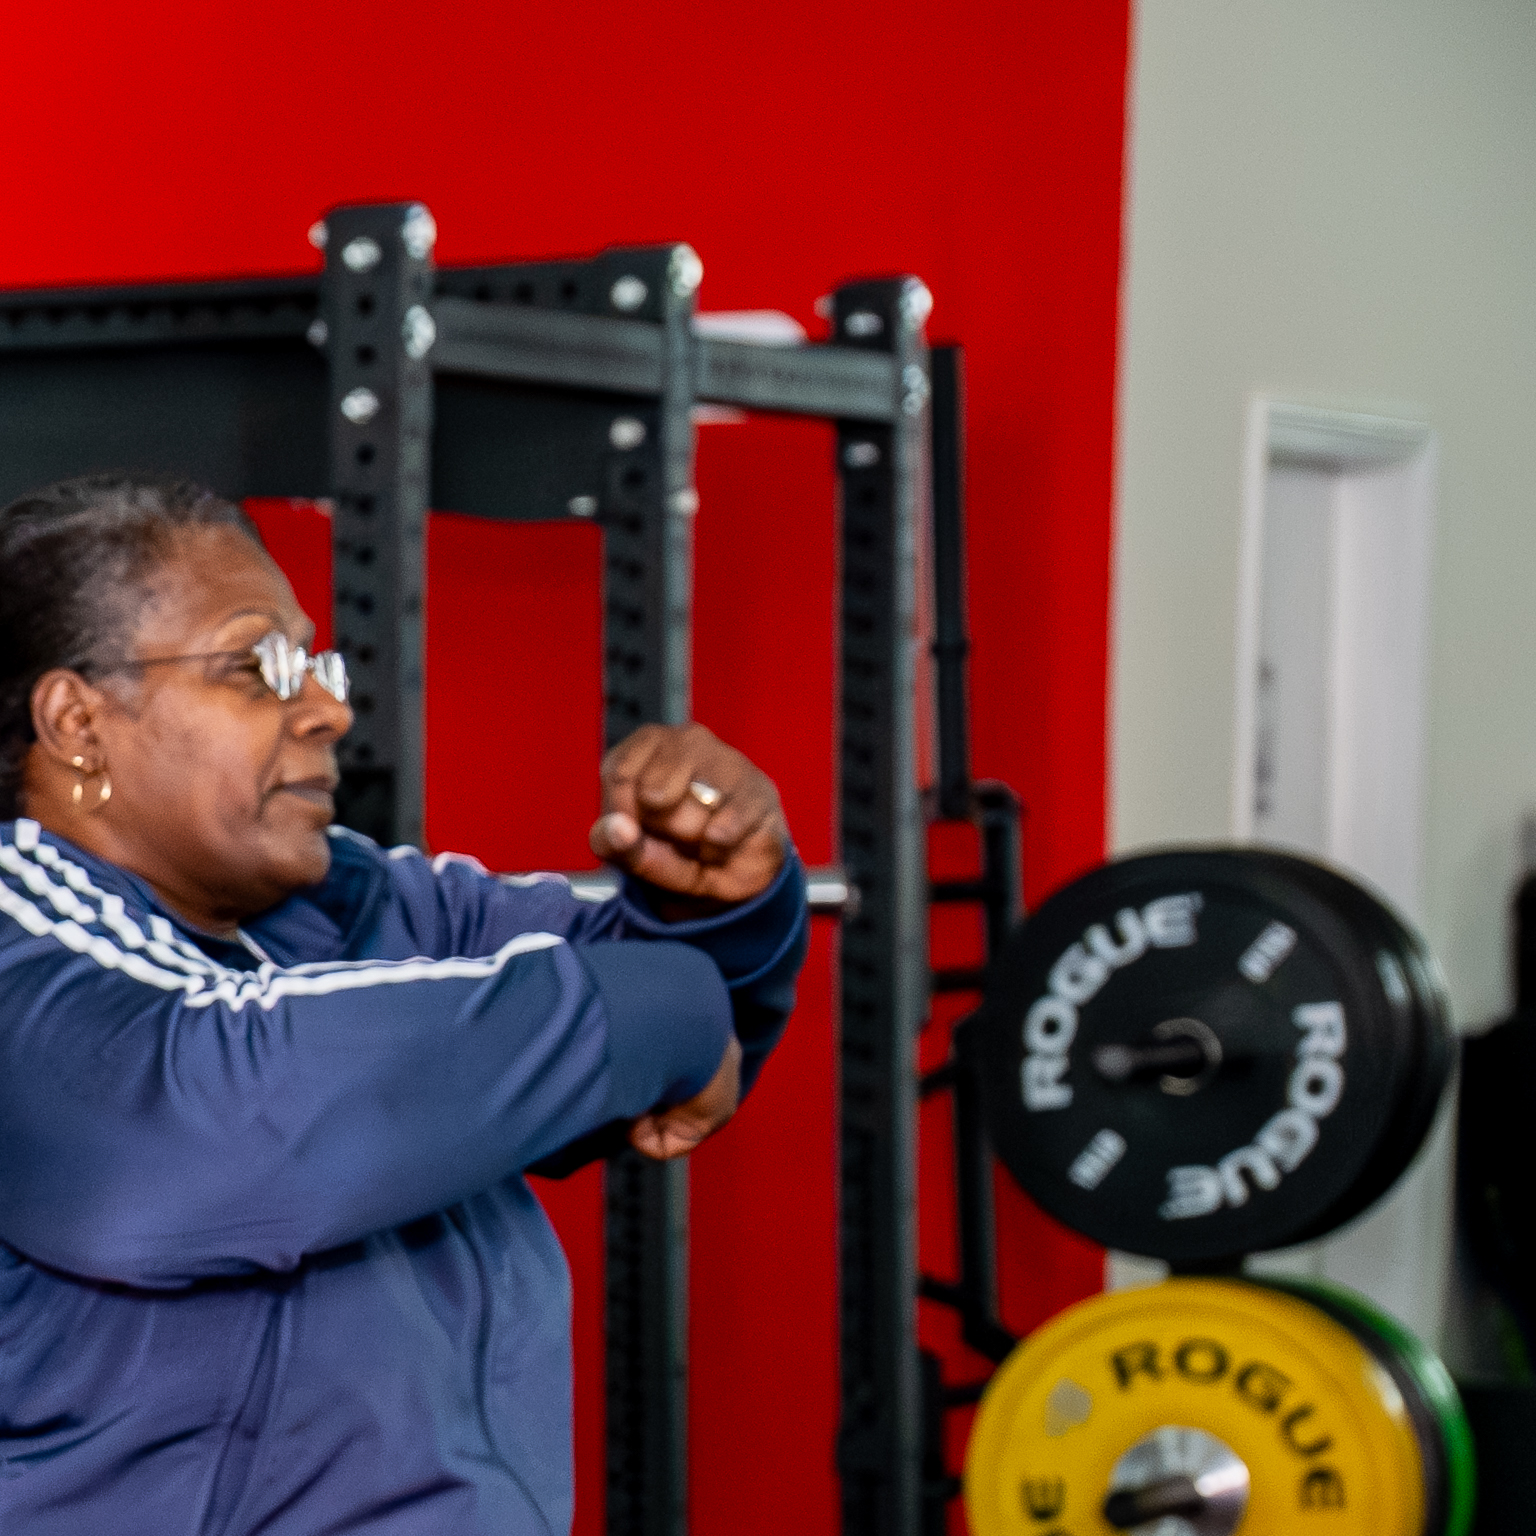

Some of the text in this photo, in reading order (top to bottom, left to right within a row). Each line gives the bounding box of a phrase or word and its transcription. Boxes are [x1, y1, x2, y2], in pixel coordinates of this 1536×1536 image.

[1021, 892, 1202, 1111] ROGUE
[1161, 1000, 1347, 1220] ROGUE
[1111, 1338, 1345, 1510] ROGUE
